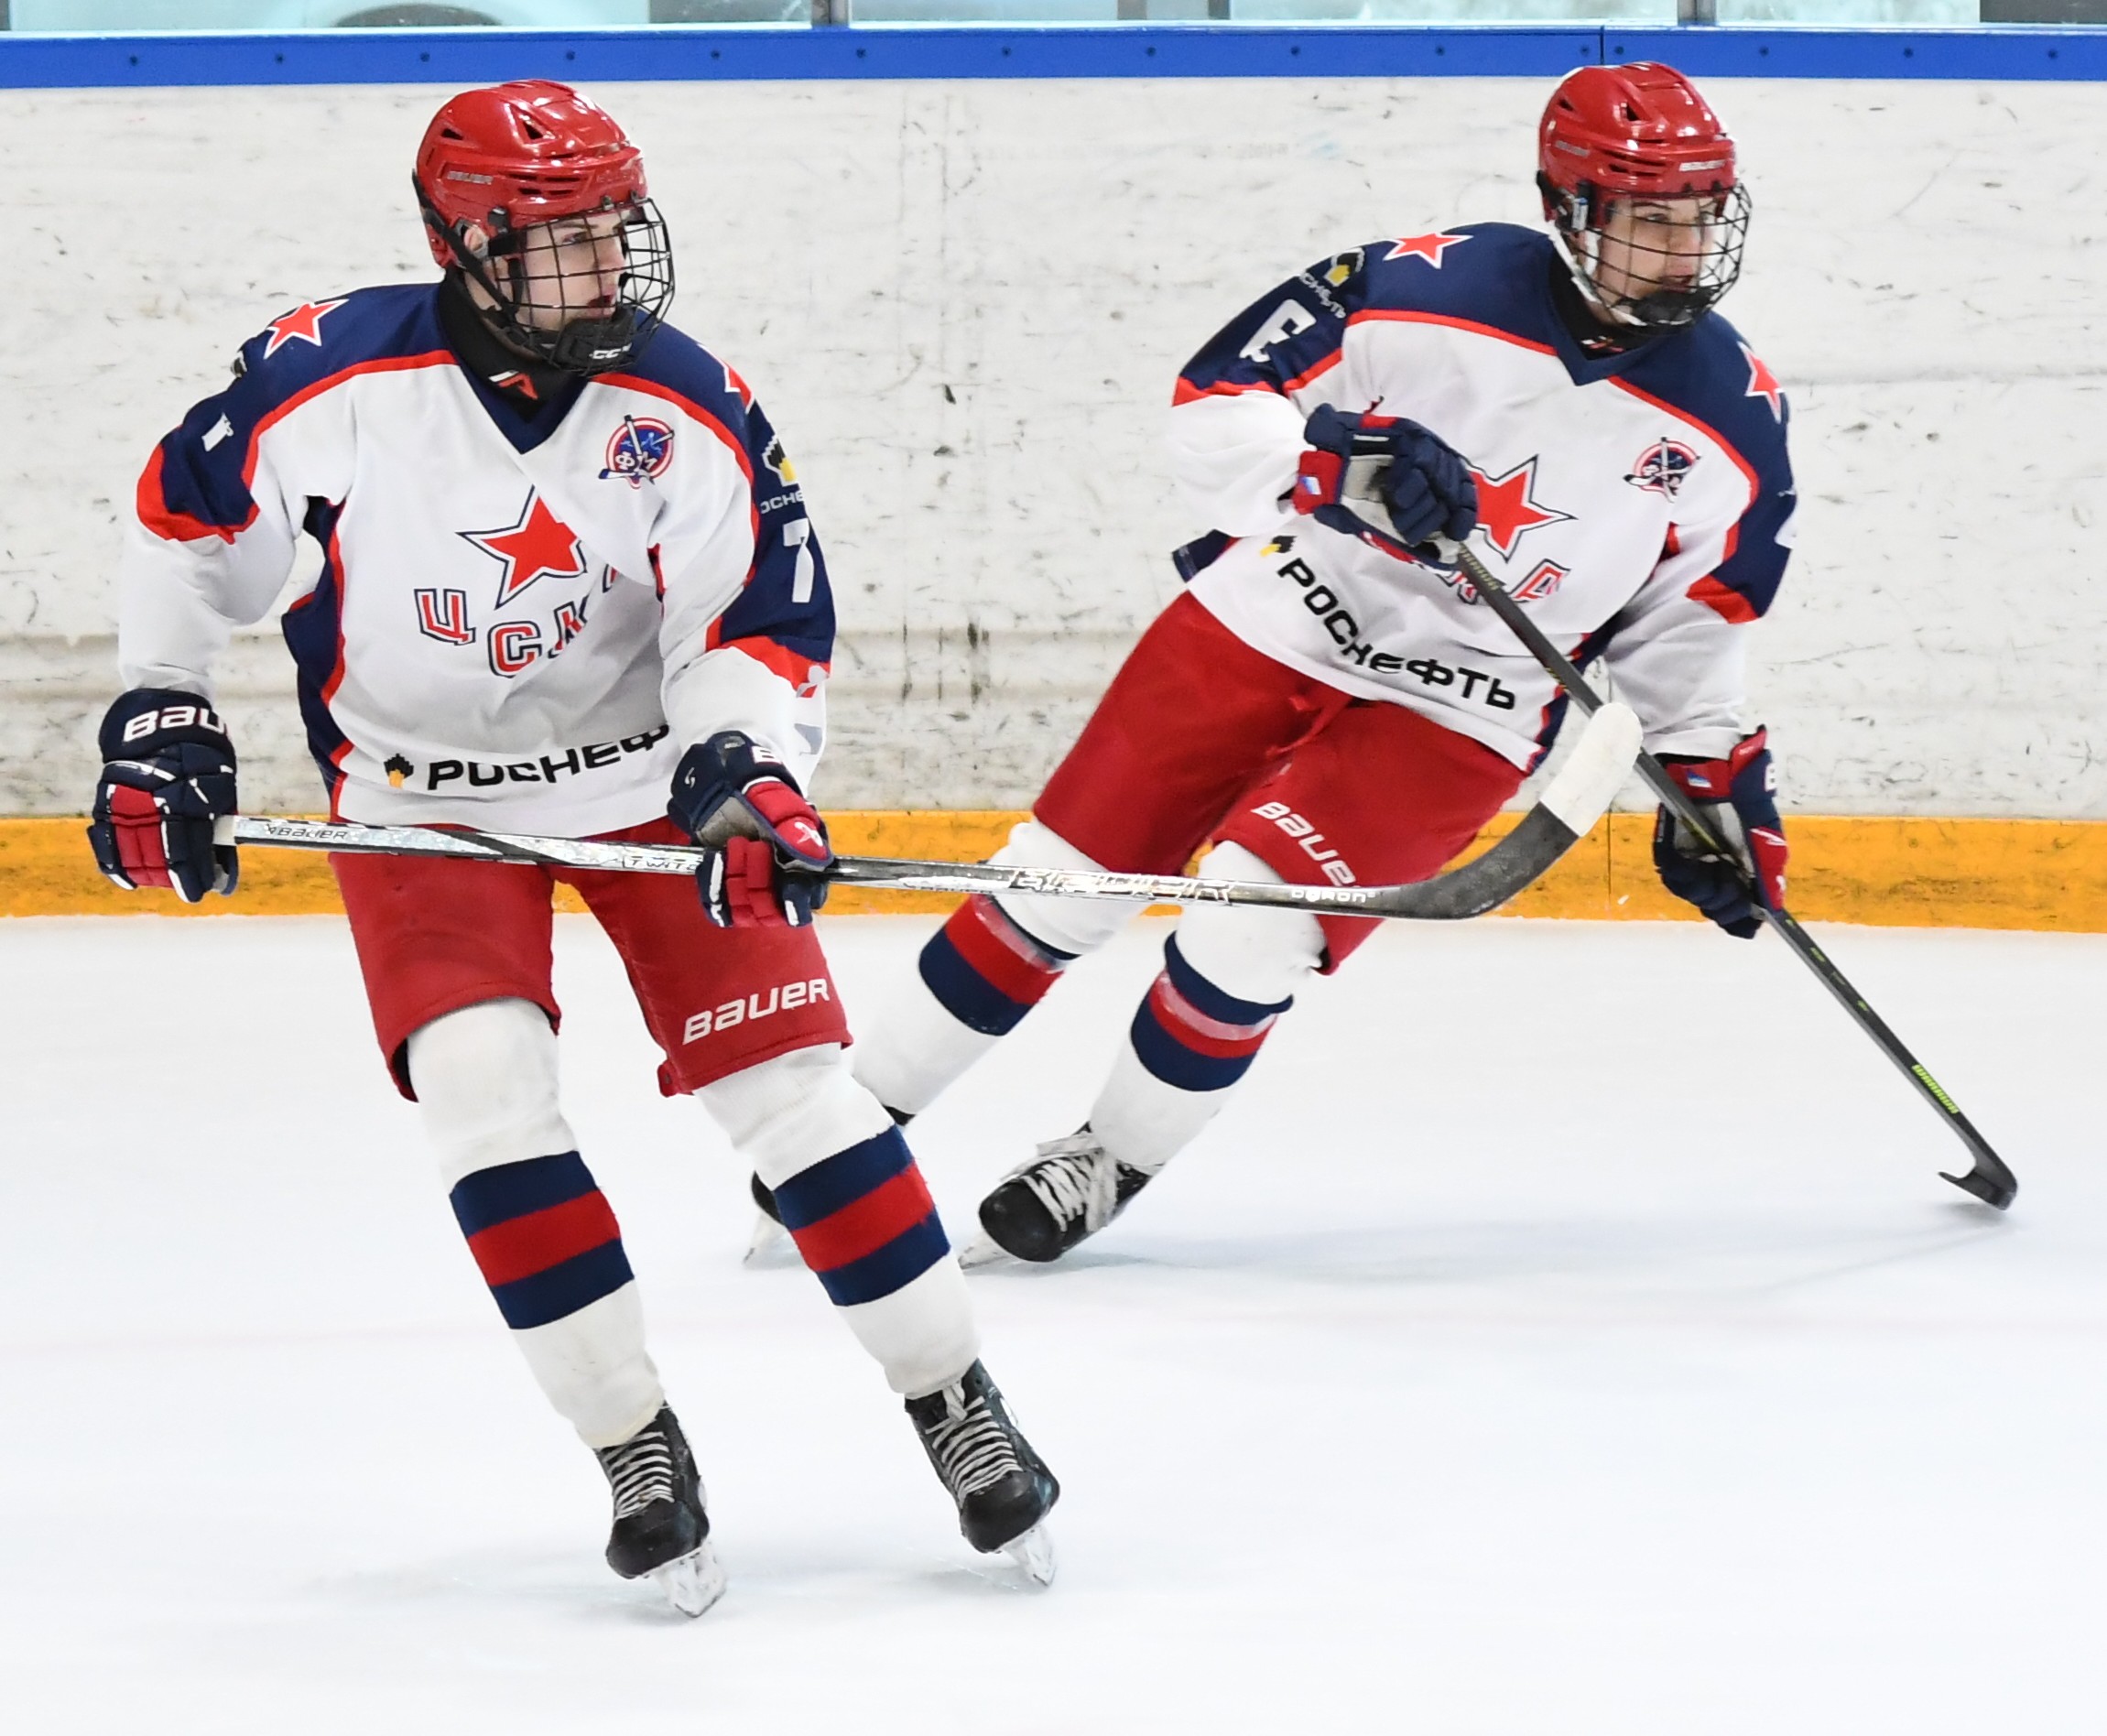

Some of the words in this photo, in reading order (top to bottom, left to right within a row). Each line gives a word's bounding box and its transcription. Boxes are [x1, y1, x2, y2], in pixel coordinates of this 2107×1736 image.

[414, 563, 618, 678] ЦСК
[1277, 557, 1515, 711] РОСНЕФТЬ
[1250, 801, 1359, 887] BAUE
[682, 978, 830, 1046] BAUER
